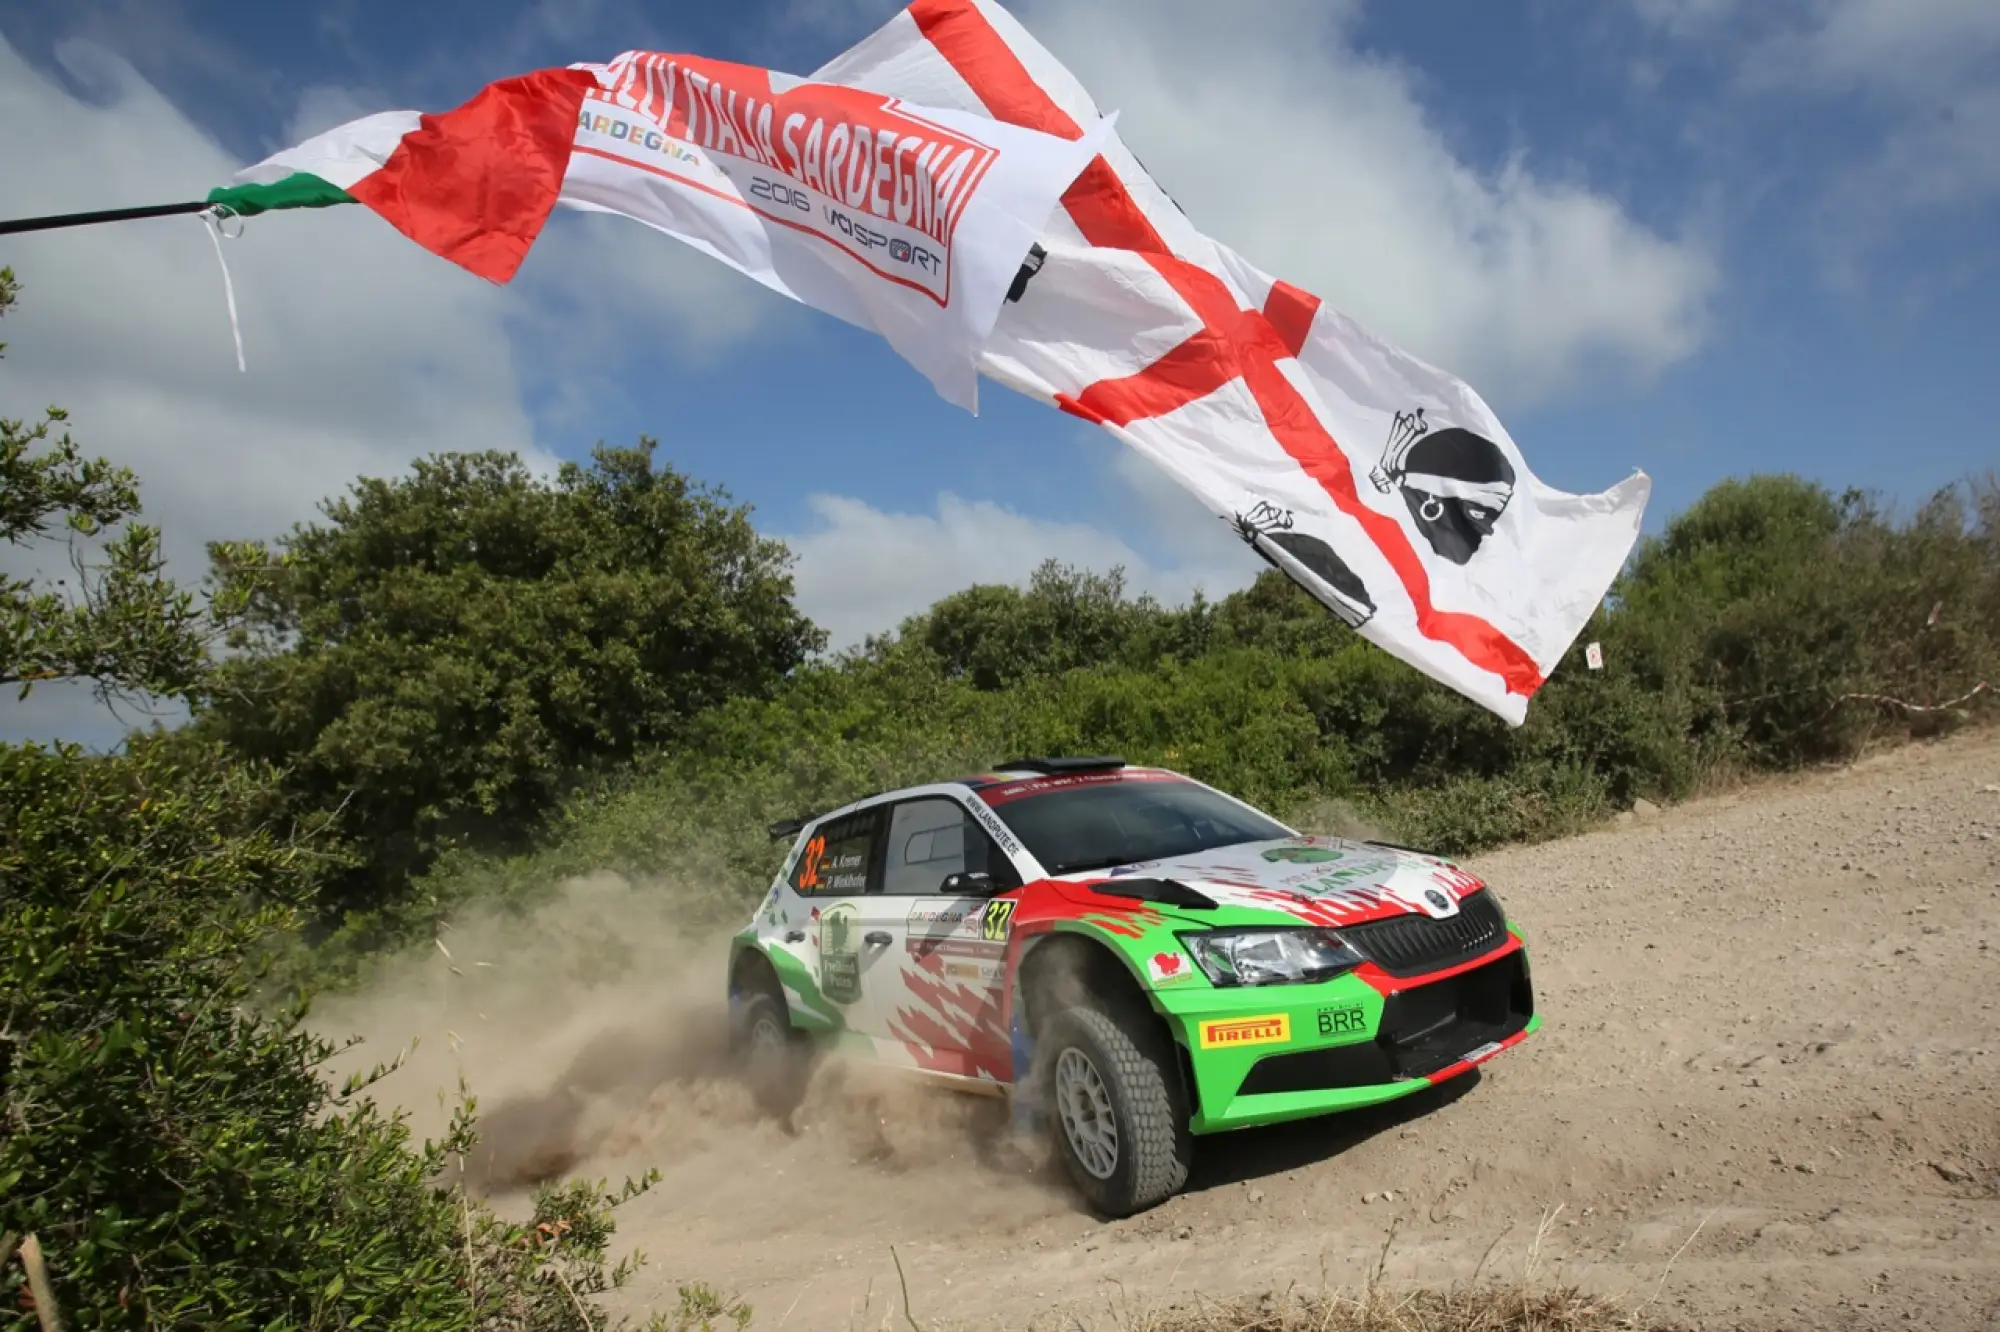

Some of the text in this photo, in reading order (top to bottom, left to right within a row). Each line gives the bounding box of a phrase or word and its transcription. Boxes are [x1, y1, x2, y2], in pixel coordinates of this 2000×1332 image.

[578, 109, 700, 167] ARDEGNA
[682, 66, 784, 173] ITALIA
[782, 112, 976, 248] SARDEGNA
[750, 176, 811, 213] 2016
[799, 835, 826, 889] 32
[984, 901, 1012, 940] 32
[1207, 1019, 1282, 1043] PIRELLI
[1318, 1010, 1367, 1034] BRR
